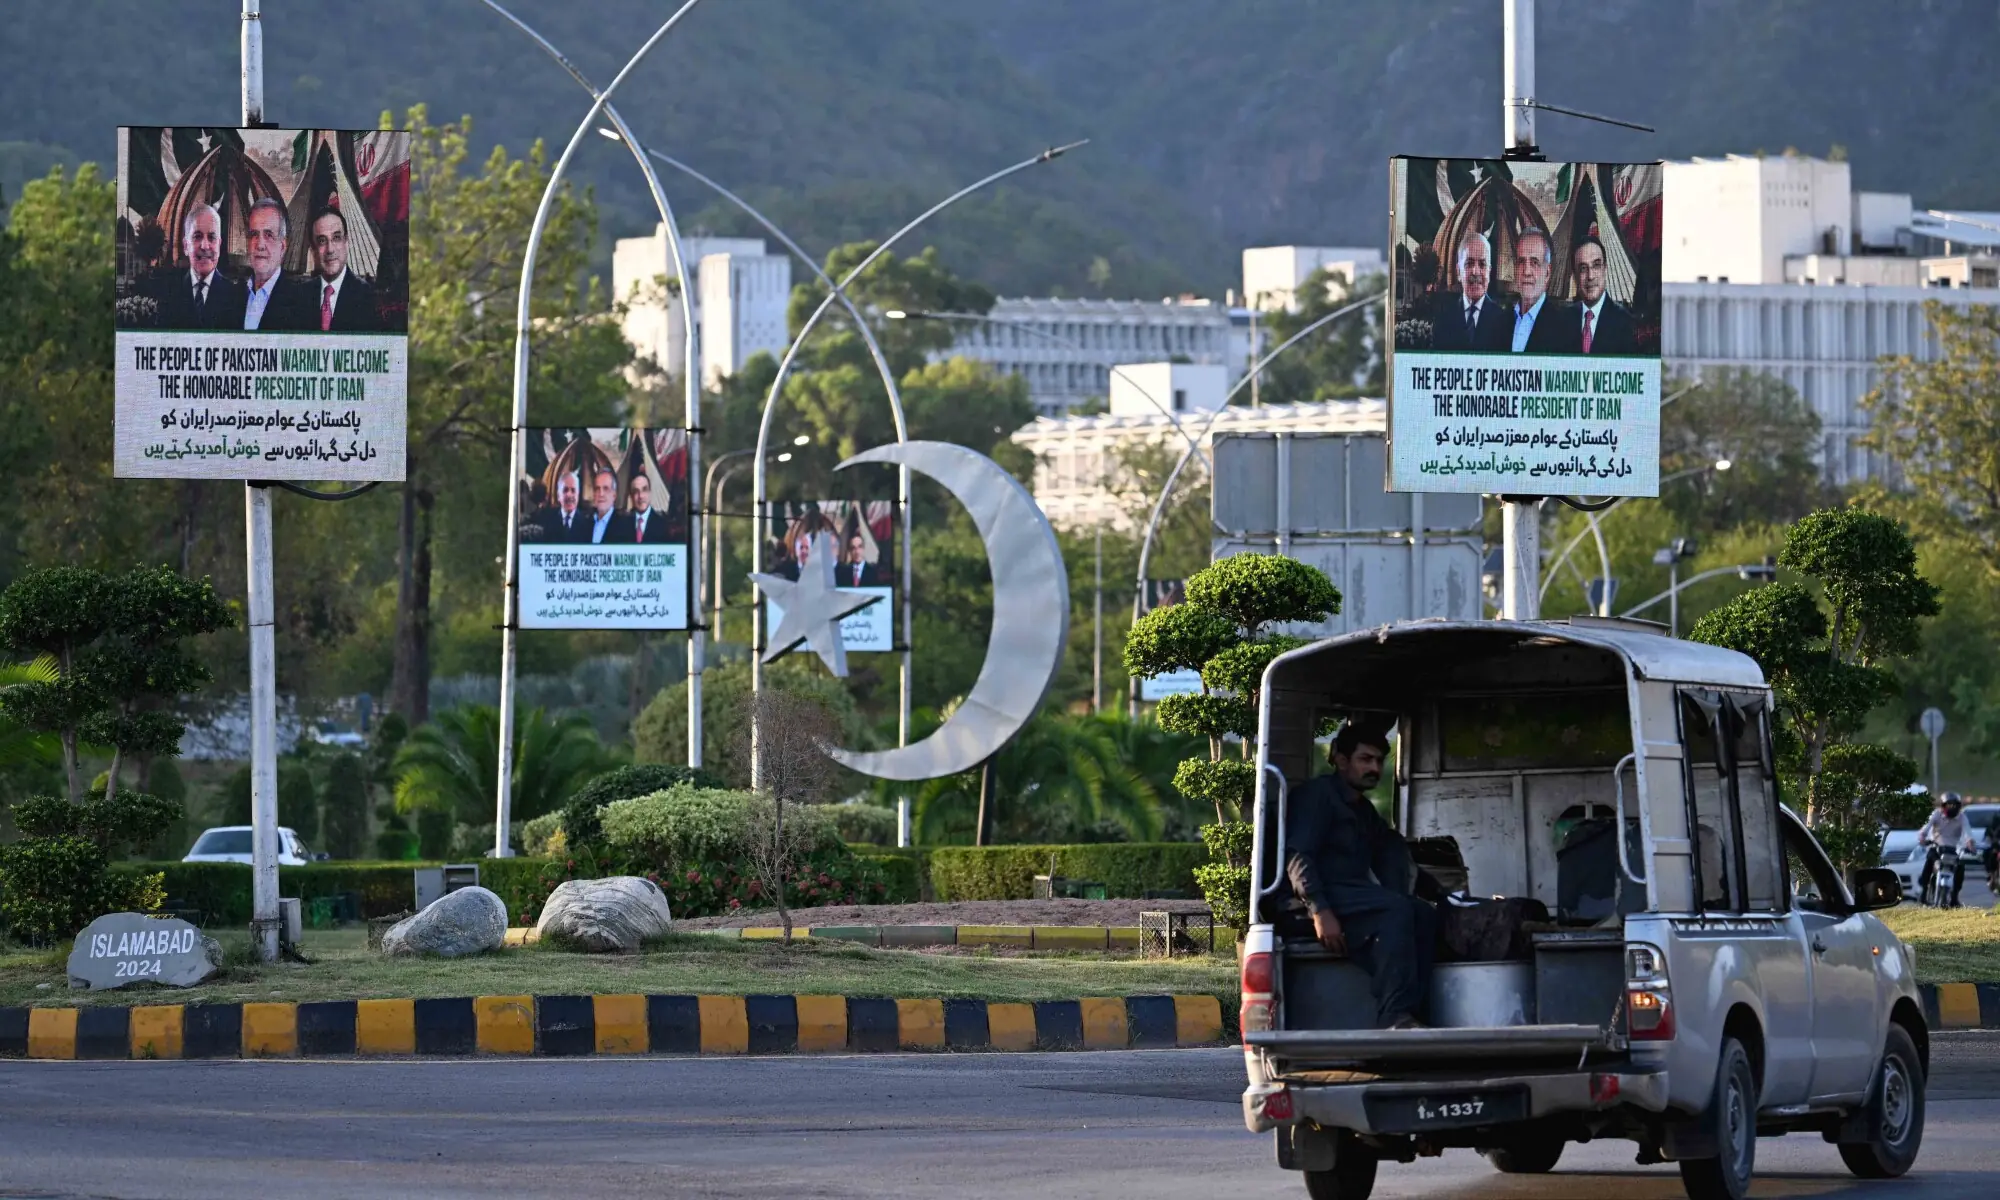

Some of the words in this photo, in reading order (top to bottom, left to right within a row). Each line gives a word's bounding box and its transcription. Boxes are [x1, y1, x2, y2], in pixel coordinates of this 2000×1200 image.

[134, 346, 156, 371] THE
[159, 347, 202, 372] PEOPLE
[205, 347, 220, 372] OF
[222, 347, 278, 372] PAKISTAN
[281, 348, 330, 373] WARMLY
[333, 349, 389, 373] WELCOME
[158, 375, 180, 399] THE
[183, 375, 252, 400] HONORABLE
[254, 376, 317, 400] PRESIDENT
[320, 377, 335, 400] OF
[337, 377, 365, 401] IRAN
[1412, 367, 1431, 390] THE
[1434, 367, 1473, 391] PEOPLE
[1475, 368, 1490, 391] OF
[1491, 368, 1542, 393] PAKISTAN
[1544, 370, 1591, 394] WARMLY
[1592, 371, 1644, 395] WELCOME
[1433, 394, 1453, 417] THE
[1456, 395, 1519, 419] HONORABLE
[1521, 396, 1579, 420] PRESIDENT
[1580, 397, 1594, 420] OF
[1596, 397, 1622, 421] IRAN
[160, 408, 177, 429] کو
[180, 408, 209, 430] ایران
[236, 410, 265, 430] معزز
[265, 409, 295, 431] عوام
[296, 410, 311, 432] کے
[311, 409, 361, 435] پاکستان
[193, 434, 228, 459] آمدید
[1435, 426, 1450, 446] کو
[1453, 426, 1479, 447] ایران
[1504, 428, 1530, 447] معزز
[1530, 428, 1558, 449] عوام
[1558, 429, 1572, 449] کے
[1572, 428, 1618, 452] پاکستان
[228, 438, 260, 459] خوش
[264, 445, 284, 461] سے
[285, 437, 338, 461] گہرائیوں
[338, 440, 358, 462] کی
[359, 440, 377, 461] دل
[1465, 451, 1496, 475] آمدید
[1495, 454, 1526, 475] خوش
[1530, 462, 1548, 476] سے
[1548, 455, 1597, 477] گہرائیوں
[1597, 457, 1615, 478] کی
[1615, 457, 1632, 477] دل
[530, 553, 543, 567] THE
[544, 553, 569, 567] PEOPLE
[570, 553, 579, 567] OF
[580, 553, 612, 567] PAKISTAN
[613, 553, 642, 567] WARMLY
[643, 553, 676, 567] WELCOME
[544, 569, 557, 583] THE
[558, 569, 598, 583] HONORABLE
[599, 569, 634, 583] PRESIDENT
[635, 569, 645, 583] OF
[646, 569, 663, 583] IRAN
[90, 929, 194, 958] ISLAMABAD
[115, 960, 162, 977] 2024
[1438, 1102, 1484, 1118] 1337
